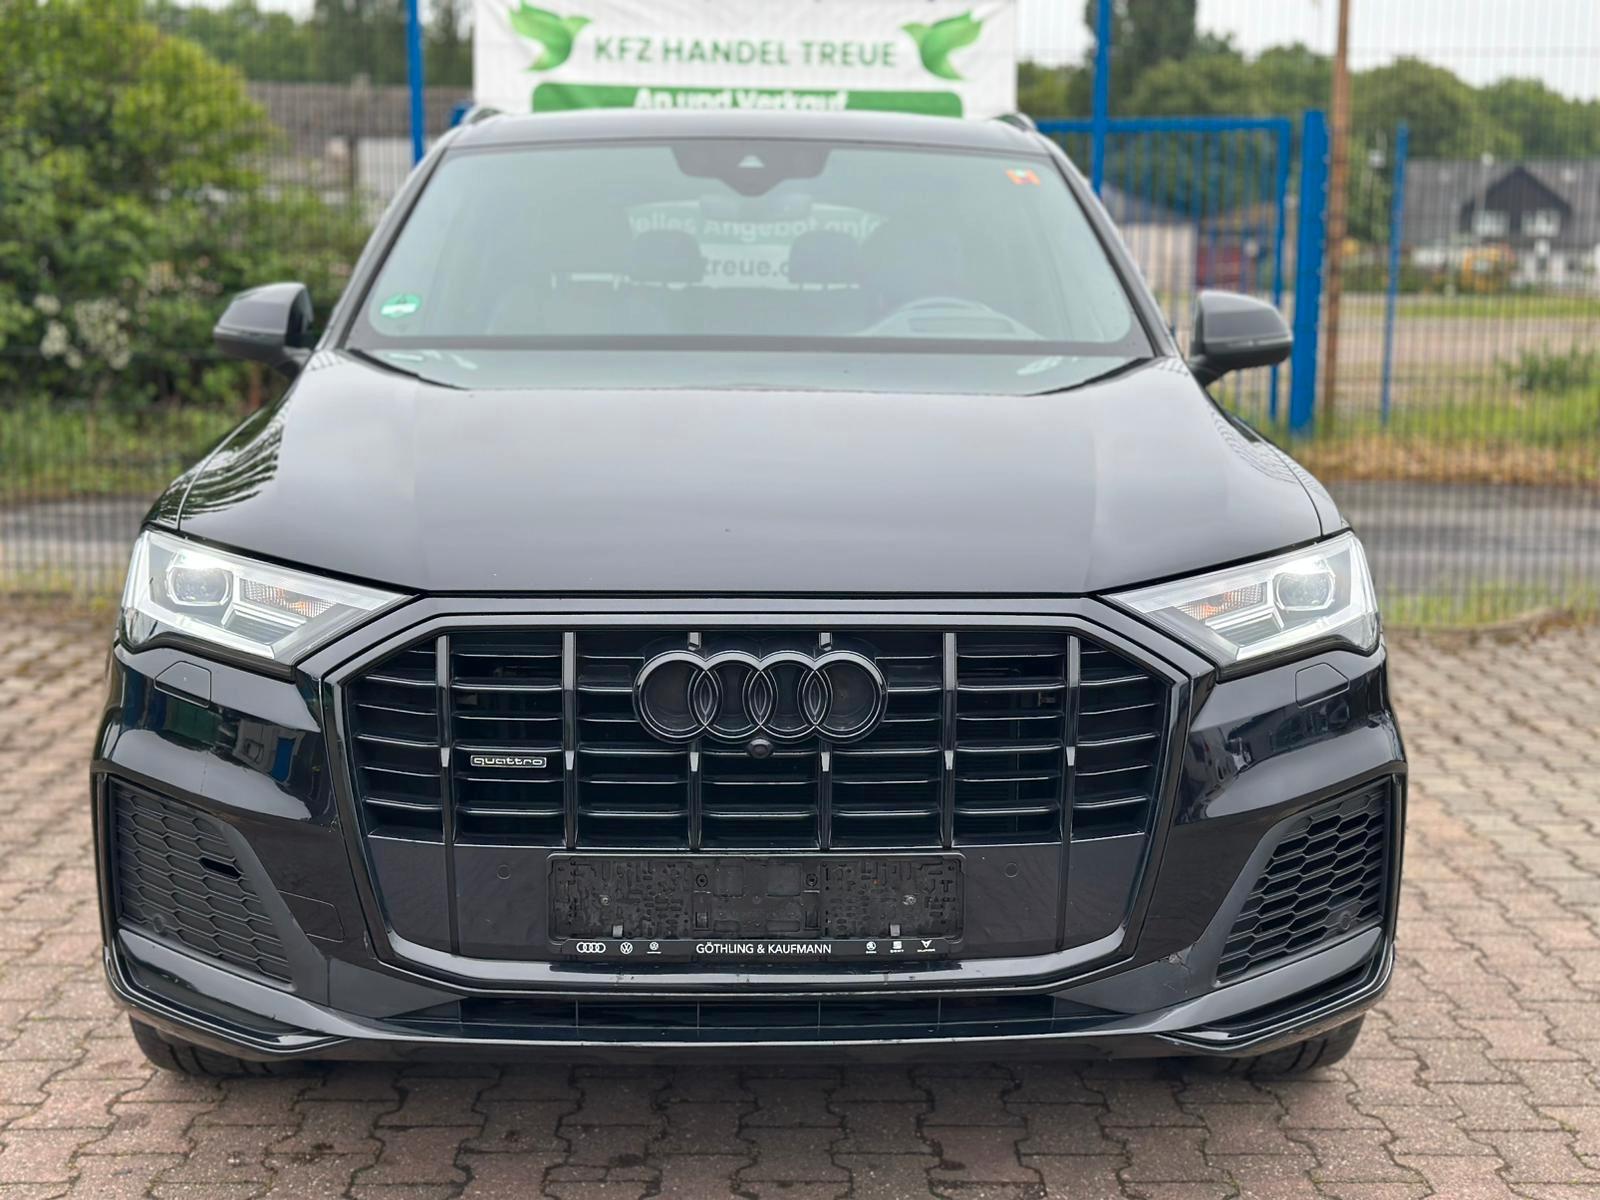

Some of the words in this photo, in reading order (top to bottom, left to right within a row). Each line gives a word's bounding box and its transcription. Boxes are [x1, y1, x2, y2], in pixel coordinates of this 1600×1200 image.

[595, 37, 652, 62] KFZ
[662, 38, 790, 66] HANDEL
[801, 41, 897, 68] TREUE
[472, 756, 544, 766] quattro
[696, 941, 754, 955] GÖTHLING
[756, 943, 766, 955] &
[768, 943, 832, 955] KAUFMANN
